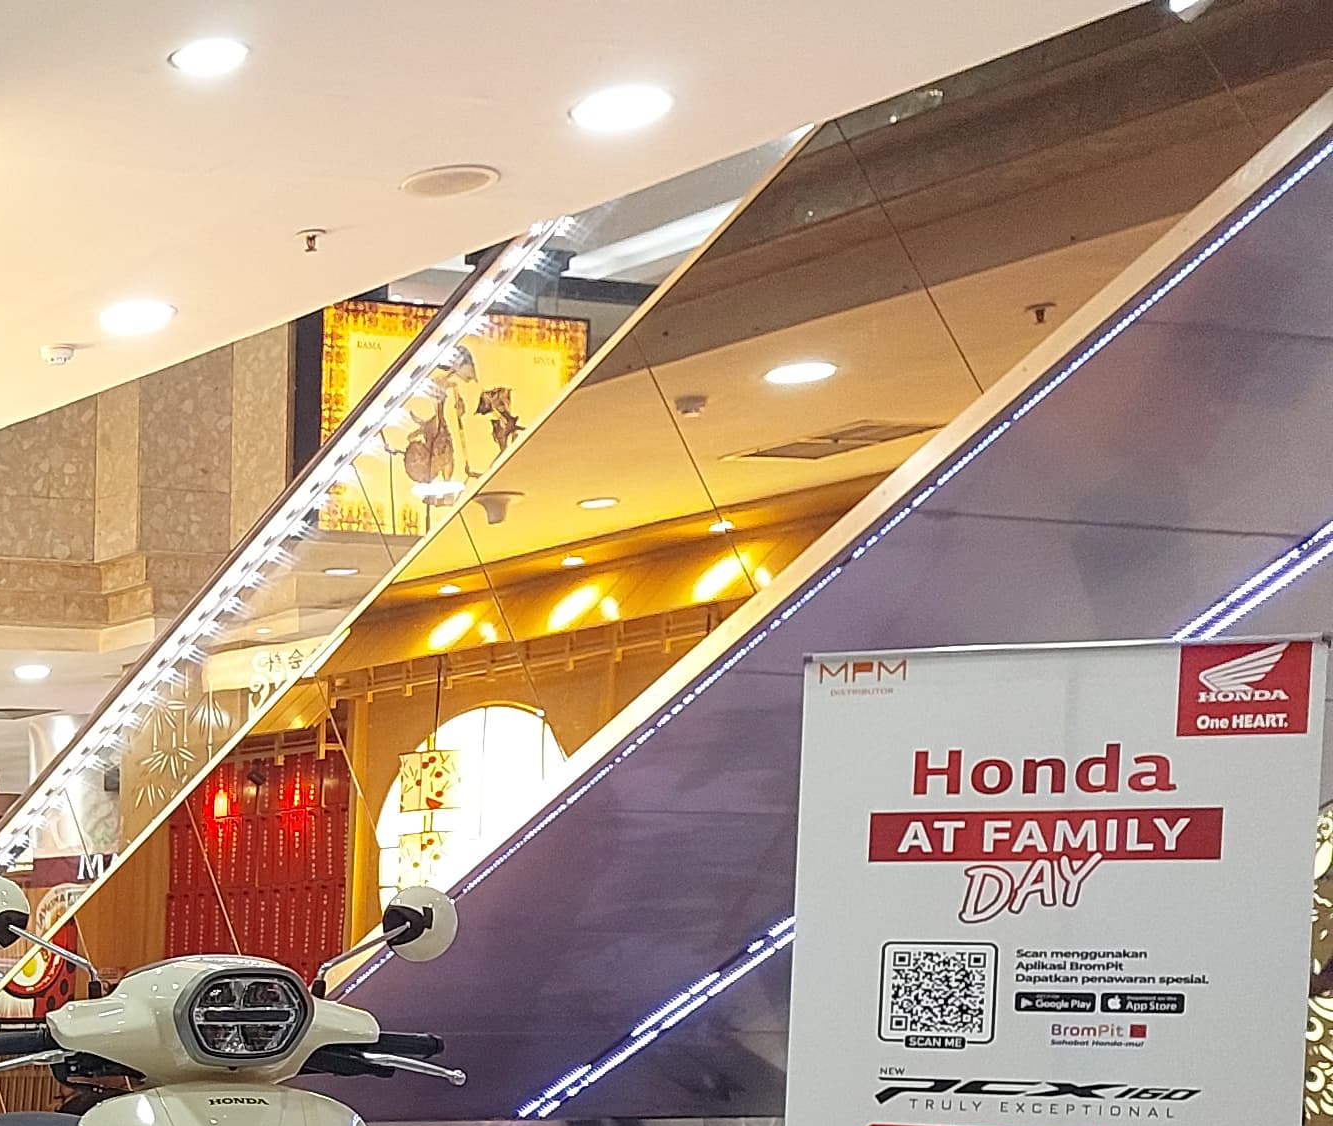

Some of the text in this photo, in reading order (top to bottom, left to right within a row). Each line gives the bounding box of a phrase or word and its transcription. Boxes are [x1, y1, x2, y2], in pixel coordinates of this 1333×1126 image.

[818, 659, 908, 685] MPM
[1197, 688, 1290, 703] HONDA
[1196, 712, 1289, 730] One HEART.
[911, 742, 1177, 796] Honda
[897, 816, 1191, 853] AT FAMILY
[957, 850, 1103, 924] DAY
[1015, 949, 1149, 961] Scan menggunakan
[1015, 961, 1125, 972] Aplikasi BromPit
[1014, 973, 1210, 987] Dapatkan penawaran spesial.
[1035, 998, 1093, 1011] Google Play
[1126, 1001, 1178, 1013] App Store
[1051, 1024, 1124, 1037] BromPit
[908, 1036, 964, 1049] SCAN ME
[879, 1067, 906, 1076] NEW
[207, 1097, 270, 1106] HONDA
[909, 1098, 1176, 1119] TRULY EXCEPTIONAL
